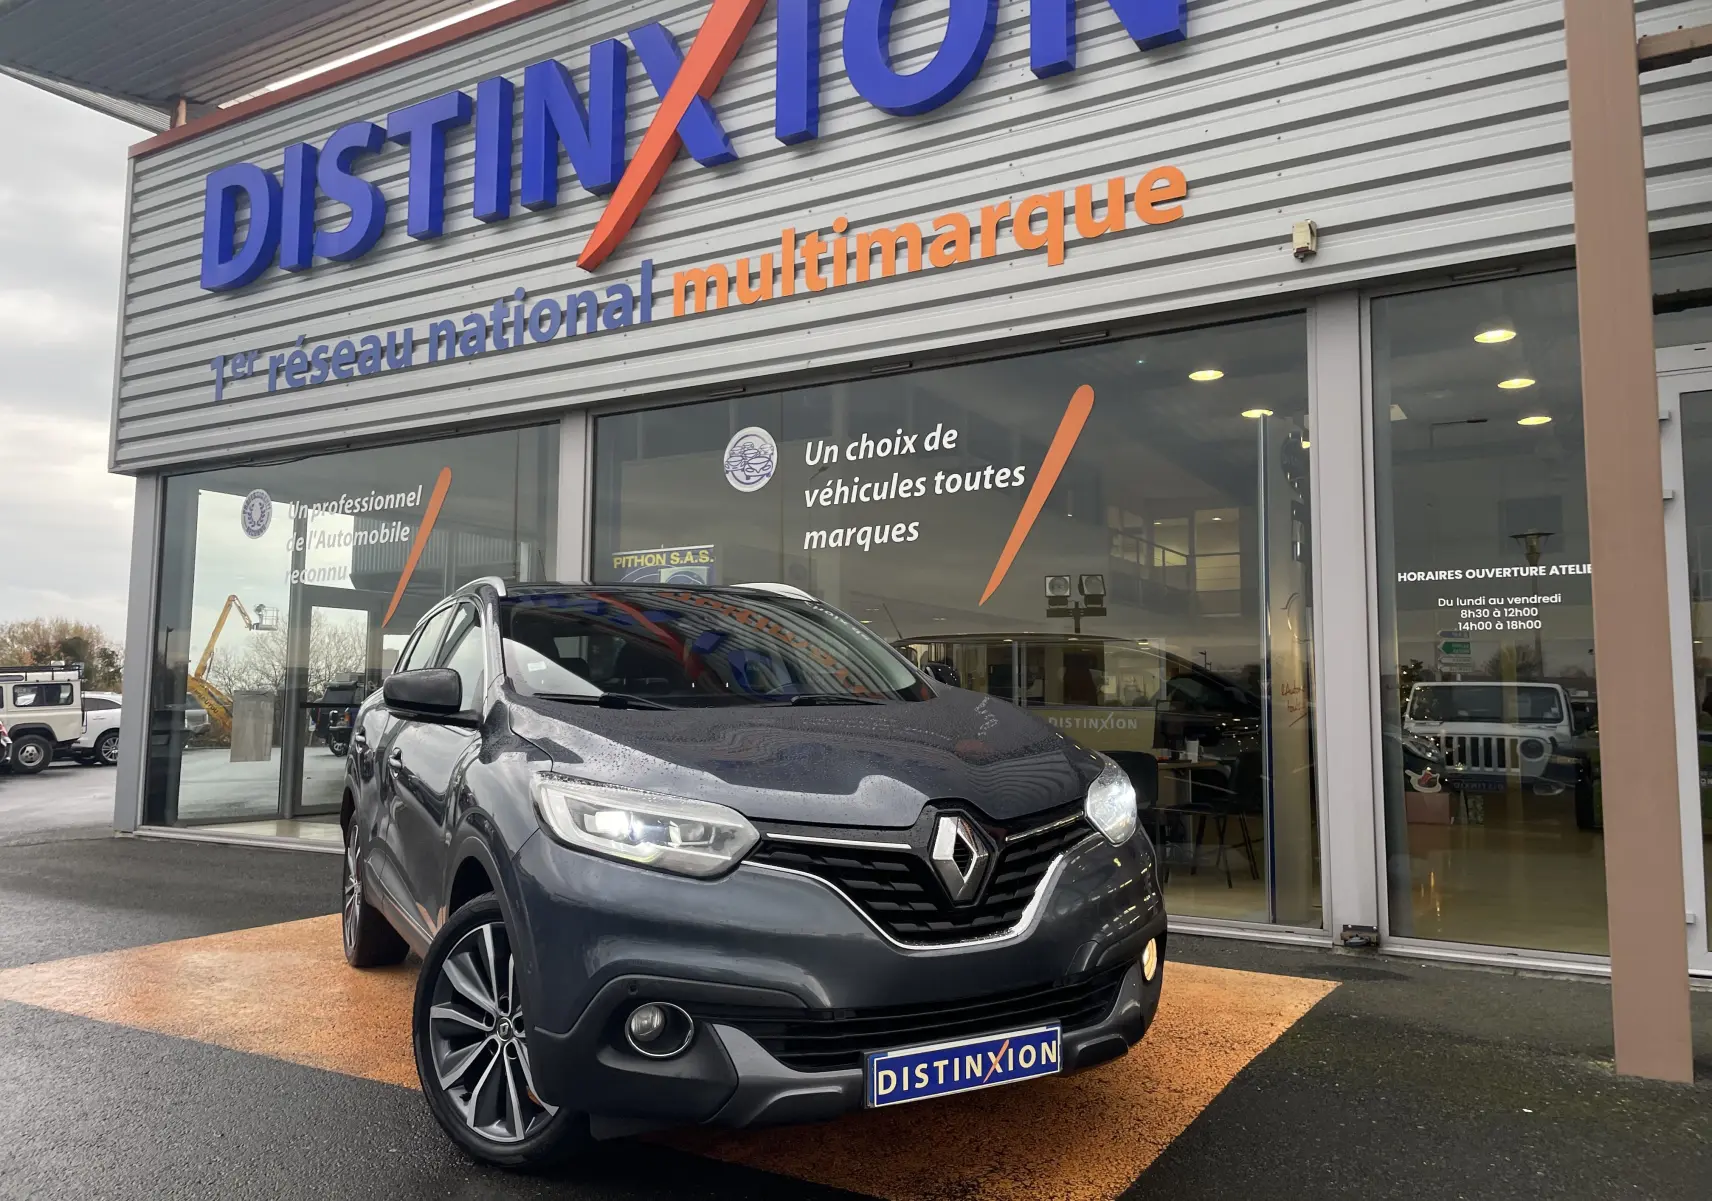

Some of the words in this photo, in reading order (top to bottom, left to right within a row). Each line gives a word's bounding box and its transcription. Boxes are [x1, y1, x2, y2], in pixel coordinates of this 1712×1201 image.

[210, 349, 260, 402] 1er
[268, 326, 413, 393] réseau
[428, 259, 655, 364] national
[672, 165, 1187, 317] multimarque
[804, 440, 840, 466] Un
[845, 428, 920, 462] choix
[923, 422, 959, 452] de
[803, 472, 927, 508] véhicules
[934, 464, 1026, 496] toutes
[287, 501, 309, 520] Un
[310, 484, 423, 523] professionnel
[286, 533, 305, 553] de
[306, 521, 411, 551] l'Automobile
[803, 519, 920, 552] marques
[613, 553, 666, 569] PITHON
[670, 549, 715, 565] S.A.S.
[284, 564, 348, 585] reconnu
[1397, 569, 1463, 583] HORAIRES
[1465, 565, 1547, 580] OUVERTURE
[1437, 597, 1454, 608] Du
[1456, 595, 1486, 607] lundi
[1488, 597, 1505, 606] au
[1507, 593, 1562, 605] vendredi
[1460, 608, 1490, 619] 8h30
[1492, 608, 1501, 618] à
[1503, 606, 1539, 618] 12h00
[1457, 620, 1493, 631] 14h00
[1495, 620, 1504, 630] à
[1506, 619, 1542, 631] 18h00
[1048, 712, 1138, 732] DISTINXION
[877, 1039, 1057, 1096] DISTINXION
